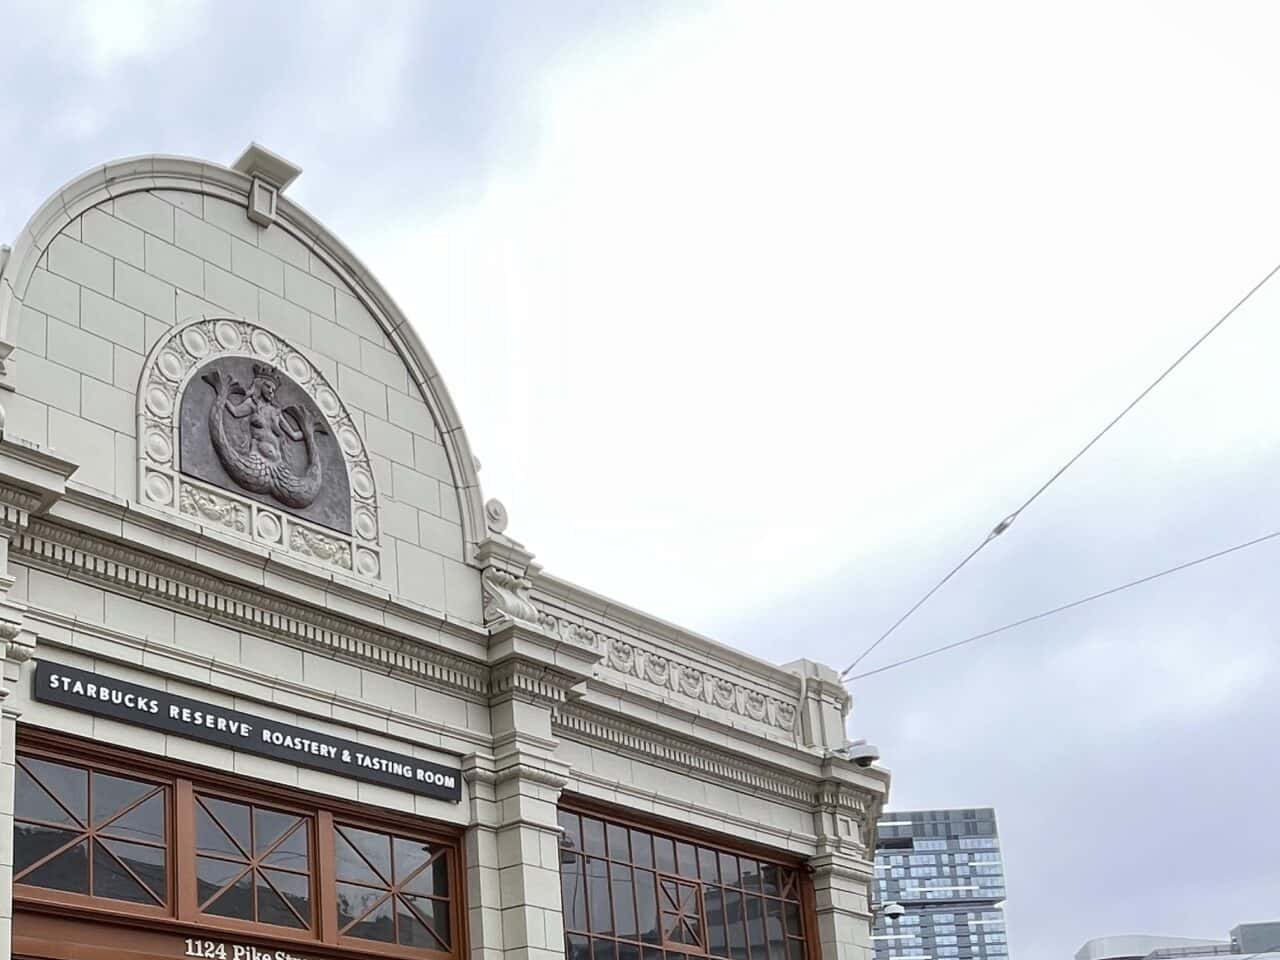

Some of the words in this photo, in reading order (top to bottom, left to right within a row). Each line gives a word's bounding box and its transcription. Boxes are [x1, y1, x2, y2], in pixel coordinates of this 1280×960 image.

[49, 674, 159, 714] STARBUCKS
[169, 705, 251, 737] RESERVE
[262, 729, 337, 759] ROASTERY
[341, 749, 352, 763] &
[356, 753, 413, 778] TASTING
[416, 769, 455, 789] ROOM
[185, 938, 227, 960] 1124
